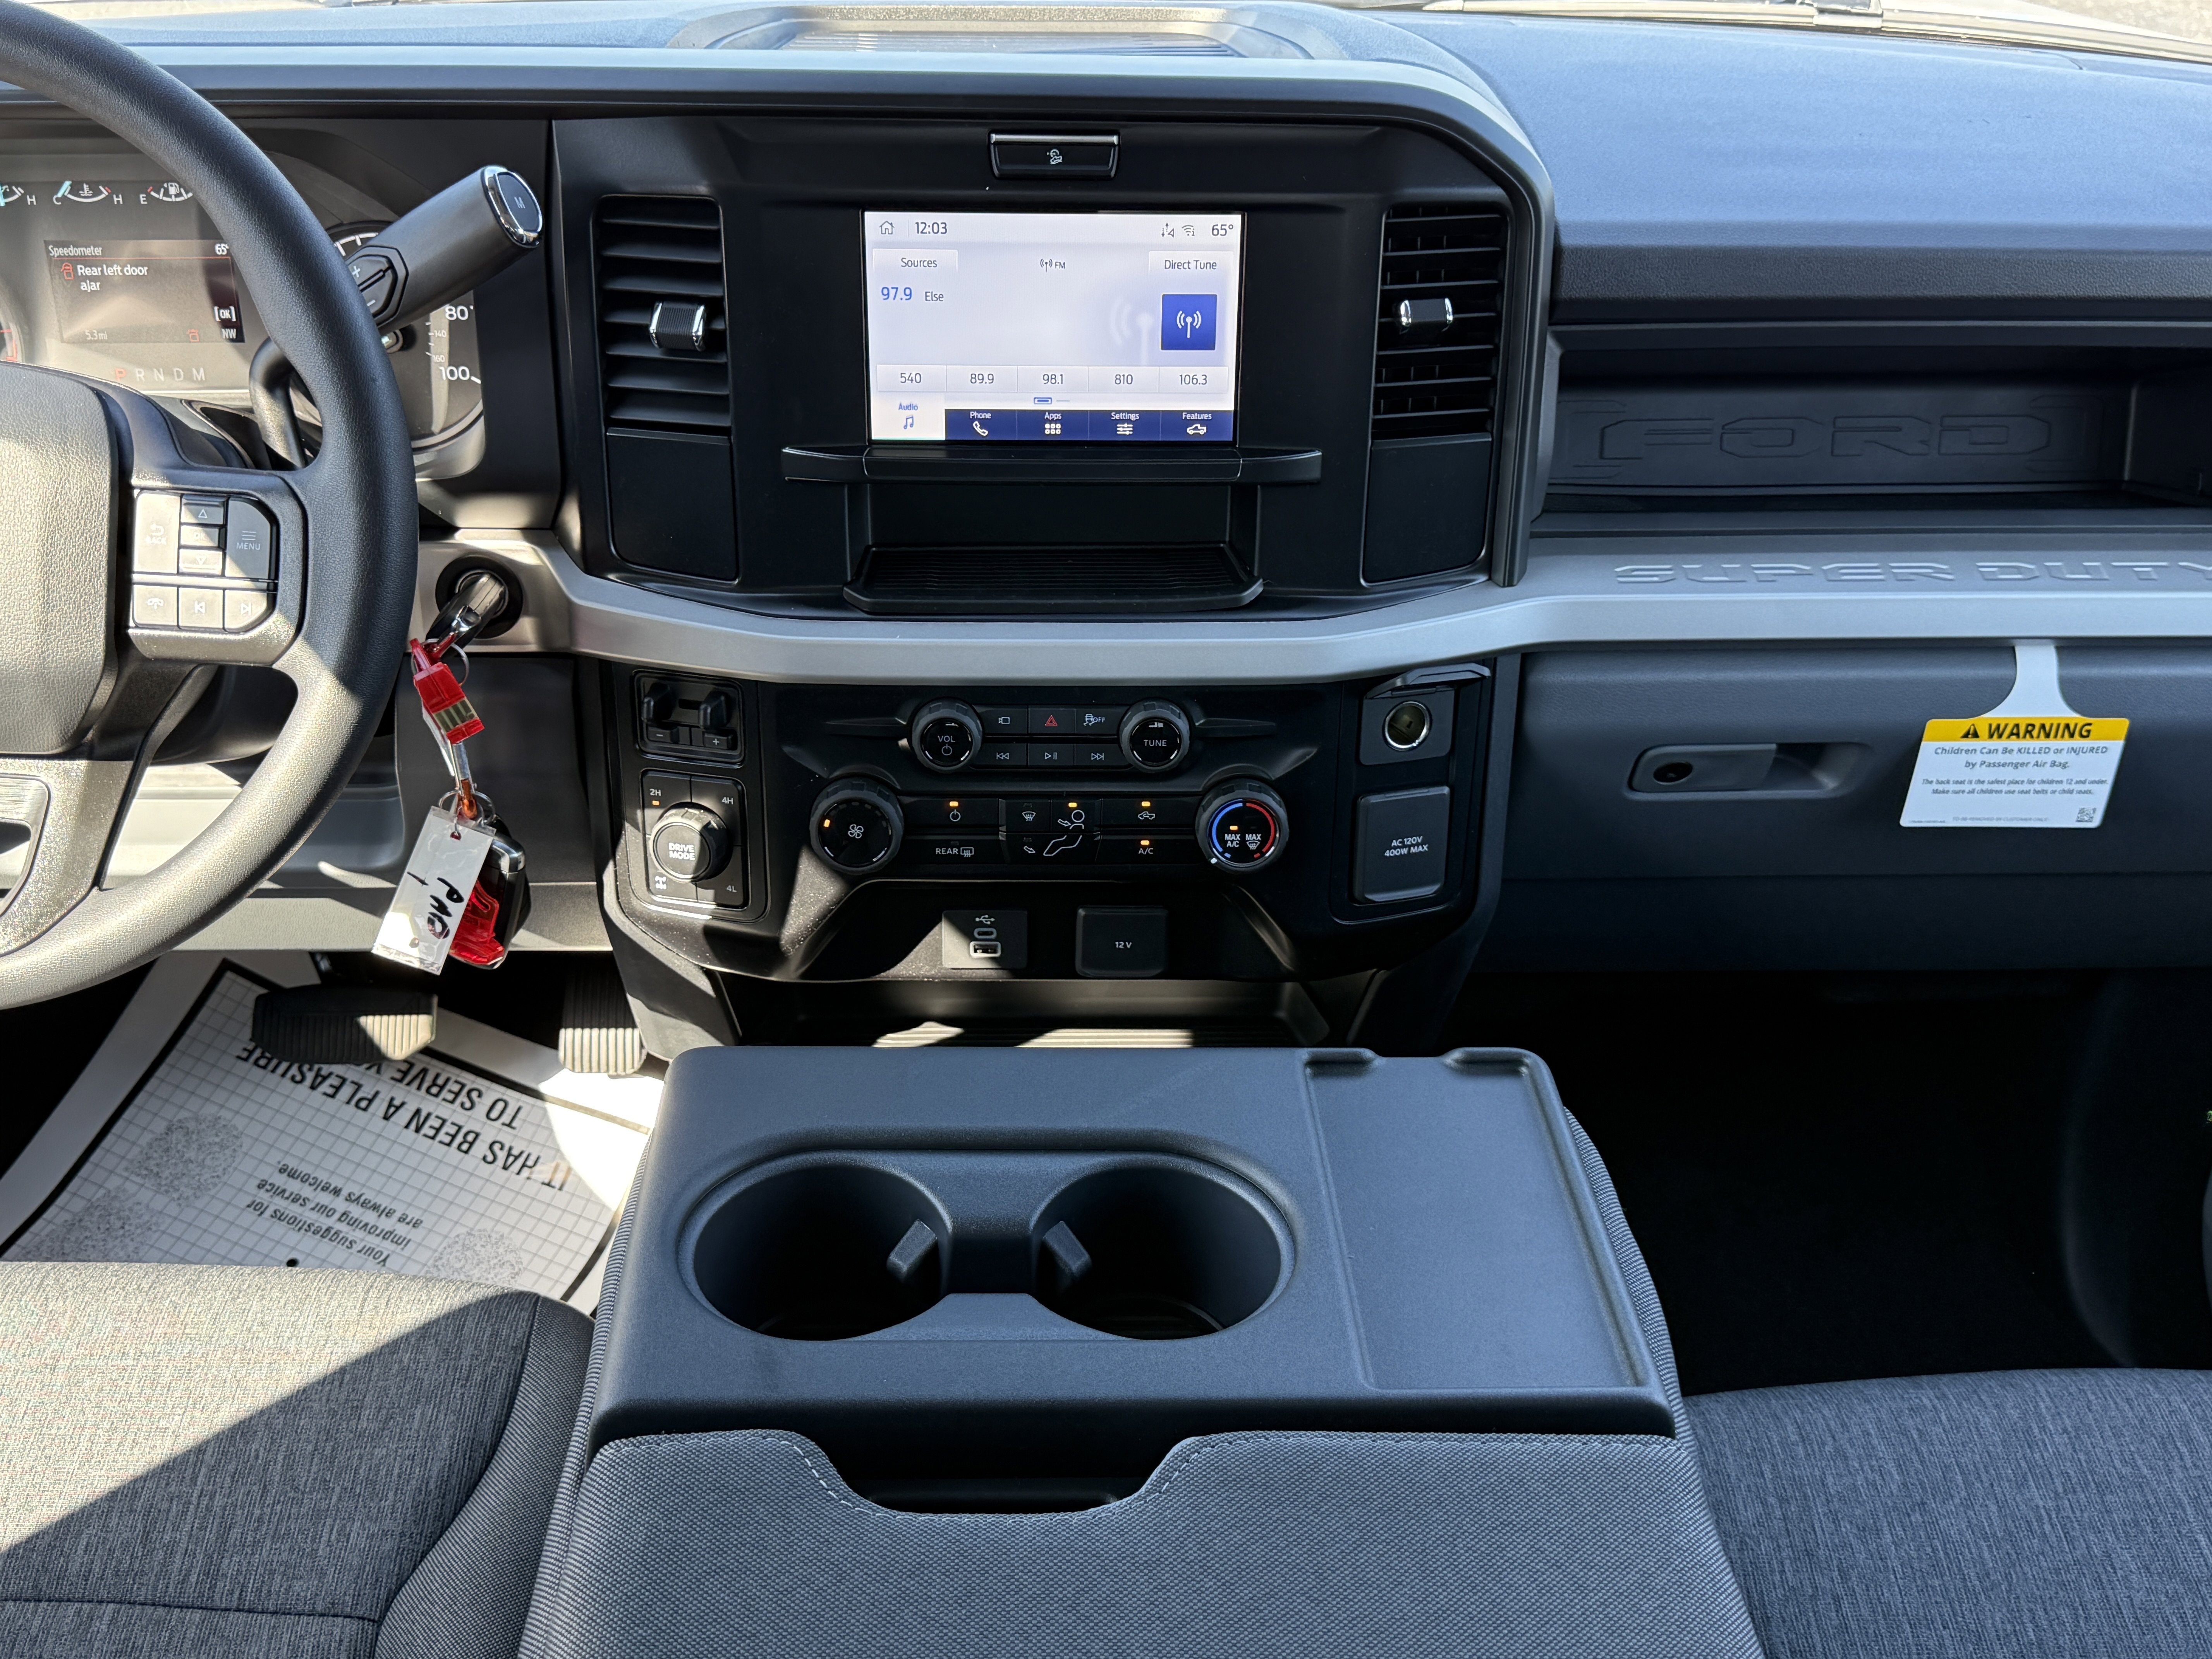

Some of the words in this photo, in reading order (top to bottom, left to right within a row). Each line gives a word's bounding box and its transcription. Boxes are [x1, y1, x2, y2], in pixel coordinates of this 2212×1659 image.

[26, 195, 36, 205] H
[53, 195, 61, 204] C
[113, 194, 123, 204] H
[140, 194, 148, 204] E
[514, 197, 526, 209] M
[915, 222, 948, 235] 12:03
[1211, 223, 1234, 237] 65°
[48, 245, 103, 258] Speedometer
[900, 257, 938, 268] Sources
[1164, 259, 1191, 270] Direct
[1194, 259, 1217, 270] Tune
[77, 264, 102, 276] Rear
[103, 264, 123, 275] left
[124, 264, 148, 275] door
[80, 280, 101, 292] ajar
[881, 286, 913, 301] 97.9
[924, 291, 944, 301] Else
[445, 305, 469, 320] 80
[222, 328, 236, 339] NW
[115, 368, 127, 381] P
[135, 368, 145, 381] R
[153, 368, 165, 381] N
[173, 368, 184, 381] D
[192, 367, 205, 381] M
[438, 366, 470, 380] 100
[899, 372, 922, 384] 540
[970, 373, 995, 385] 89.9
[1042, 373, 1064, 385] 98.1
[1114, 374, 1133, 385] 810
[1179, 374, 1208, 386] 106.3
[898, 402, 919, 411] Audio
[970, 411, 992, 419] Phone
[1044, 412, 1062, 421] Apps
[1111, 412, 1140, 421] Settings
[1182, 412, 1212, 420] Features
[1599, 414, 2052, 460] FORD
[236, 542, 261, 551] MENU
[1613, 563, 1956, 583] SUPER
[1987, 723, 2093, 739] WARNING
[1934, 747, 1977, 755] Children
[2066, 746, 2108, 756] INJURED
[1964, 760, 1977, 769] by
[1979, 760, 2030, 769] Passenger
[2049, 760, 2070, 769] Bag.
[649, 788, 661, 796] 2H
[721, 796, 734, 805] 4H
[1404, 836, 1423, 845] 120V
[668, 842, 695, 853] DRIVE
[1385, 848, 1408, 857] 400W
[1410, 844, 1428, 853] MAX
[668, 850, 696, 860] MODE
[726, 884, 737, 893] 4L
[390, 1059, 483, 1111] SERVE
[382, 1095, 408, 1121] A
[485, 1098, 524, 1130] TO
[404, 1107, 481, 1154] BEEN
[483, 1141, 542, 1180] HAS
[277, 1161, 343, 1198] welcome.
[257, 1178, 311, 1207] service
[246, 1199, 270, 1217] for
[310, 1202, 337, 1218] our
[345, 1190, 397, 1218] always
[398, 1214, 423, 1229] are
[270, 1207, 357, 1250] suggestions
[337, 1209, 412, 1251] improving
[357, 1245, 390, 1267] Your
